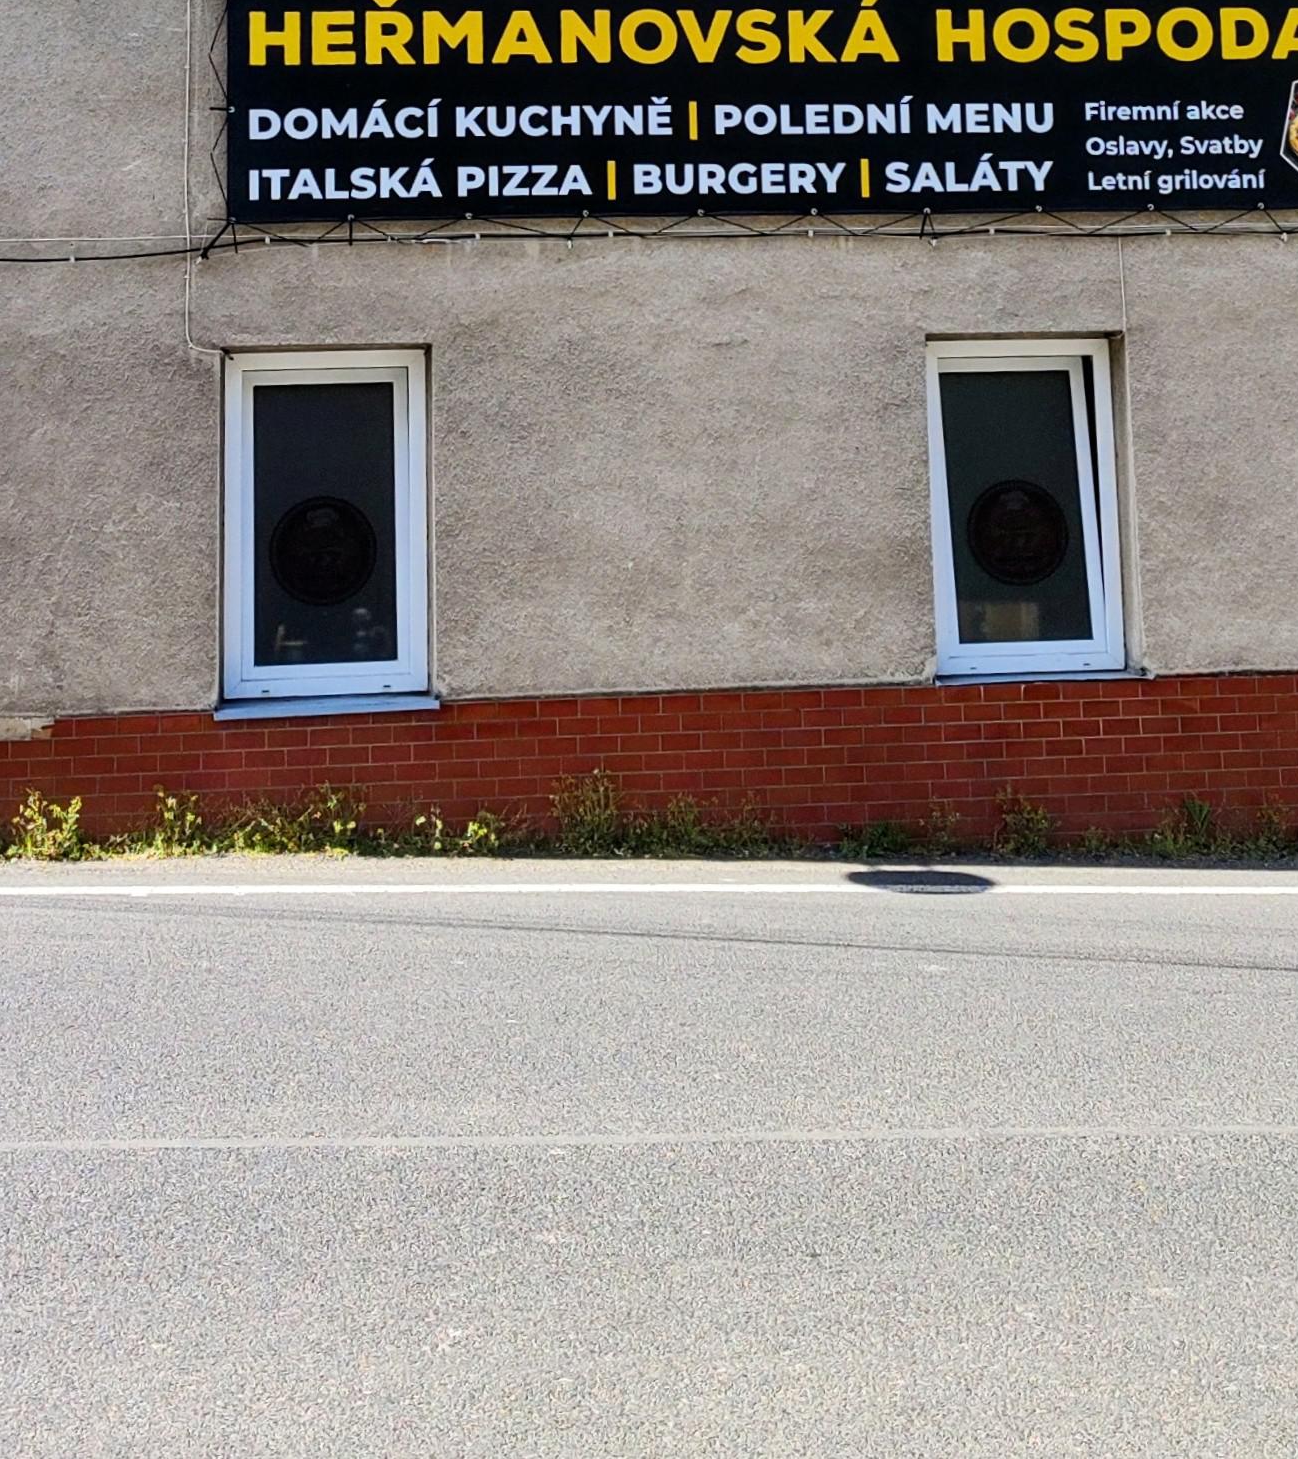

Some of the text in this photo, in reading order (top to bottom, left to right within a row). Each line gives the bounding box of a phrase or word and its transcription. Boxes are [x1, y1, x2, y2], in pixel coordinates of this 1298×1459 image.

[249, 96, 1053, 139] DOMÁCÍ KUCHYNĚ POLEDNÍ MENU
[1085, 101, 1244, 120] Firemní akce
[1086, 134, 1263, 159] Oslavy, Svatby
[249, 153, 1053, 200] ITALSKÁ PIZZA BURGERY SALÁTY
[1088, 169, 1265, 194] Letní grilování
